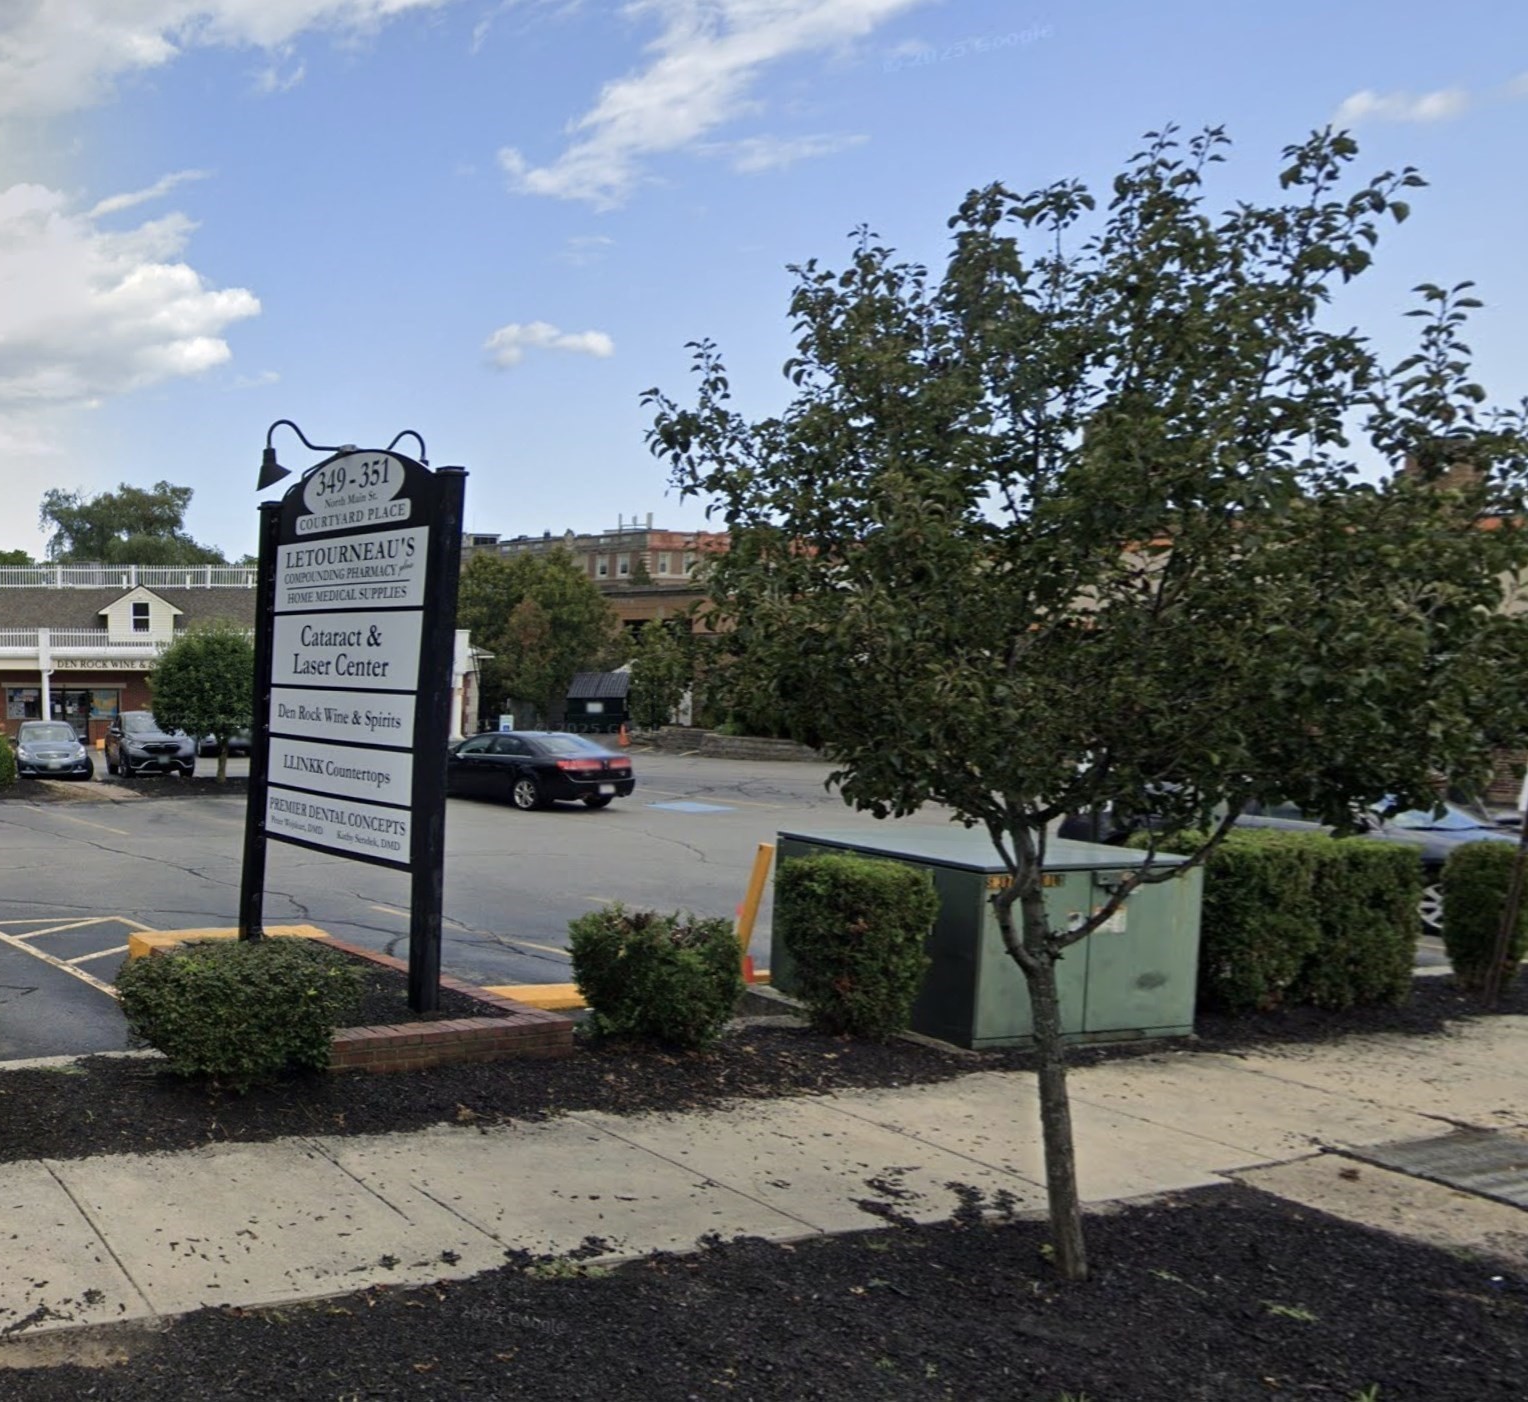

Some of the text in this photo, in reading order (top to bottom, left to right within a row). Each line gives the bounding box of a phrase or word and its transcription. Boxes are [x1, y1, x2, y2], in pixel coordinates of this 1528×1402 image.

[325, 497, 346, 509] North
[348, 492, 367, 505] Main
[299, 502, 406, 531] COURTYARD PLACE
[285, 536, 415, 569] LETOURNEAU'S
[284, 560, 414, 585] COMPOUNDING PHARMACY plus
[287, 586, 407, 604] HOME MEDICAL SUPPLIES
[300, 624, 382, 647] Cataract &
[57, 660, 77, 669] DEN
[80, 660, 109, 669] ROCK
[111, 660, 137, 669] WINE
[292, 653, 389, 678] Laser Center
[278, 703, 402, 732] Den Rock Wine & Spirits
[283, 754, 391, 788] LLINKK Countertops
[269, 796, 407, 836] PREMIER DENTAL CONCEPTS
[307, 823, 324, 835] DMD
[380, 838, 401, 851] DMD
